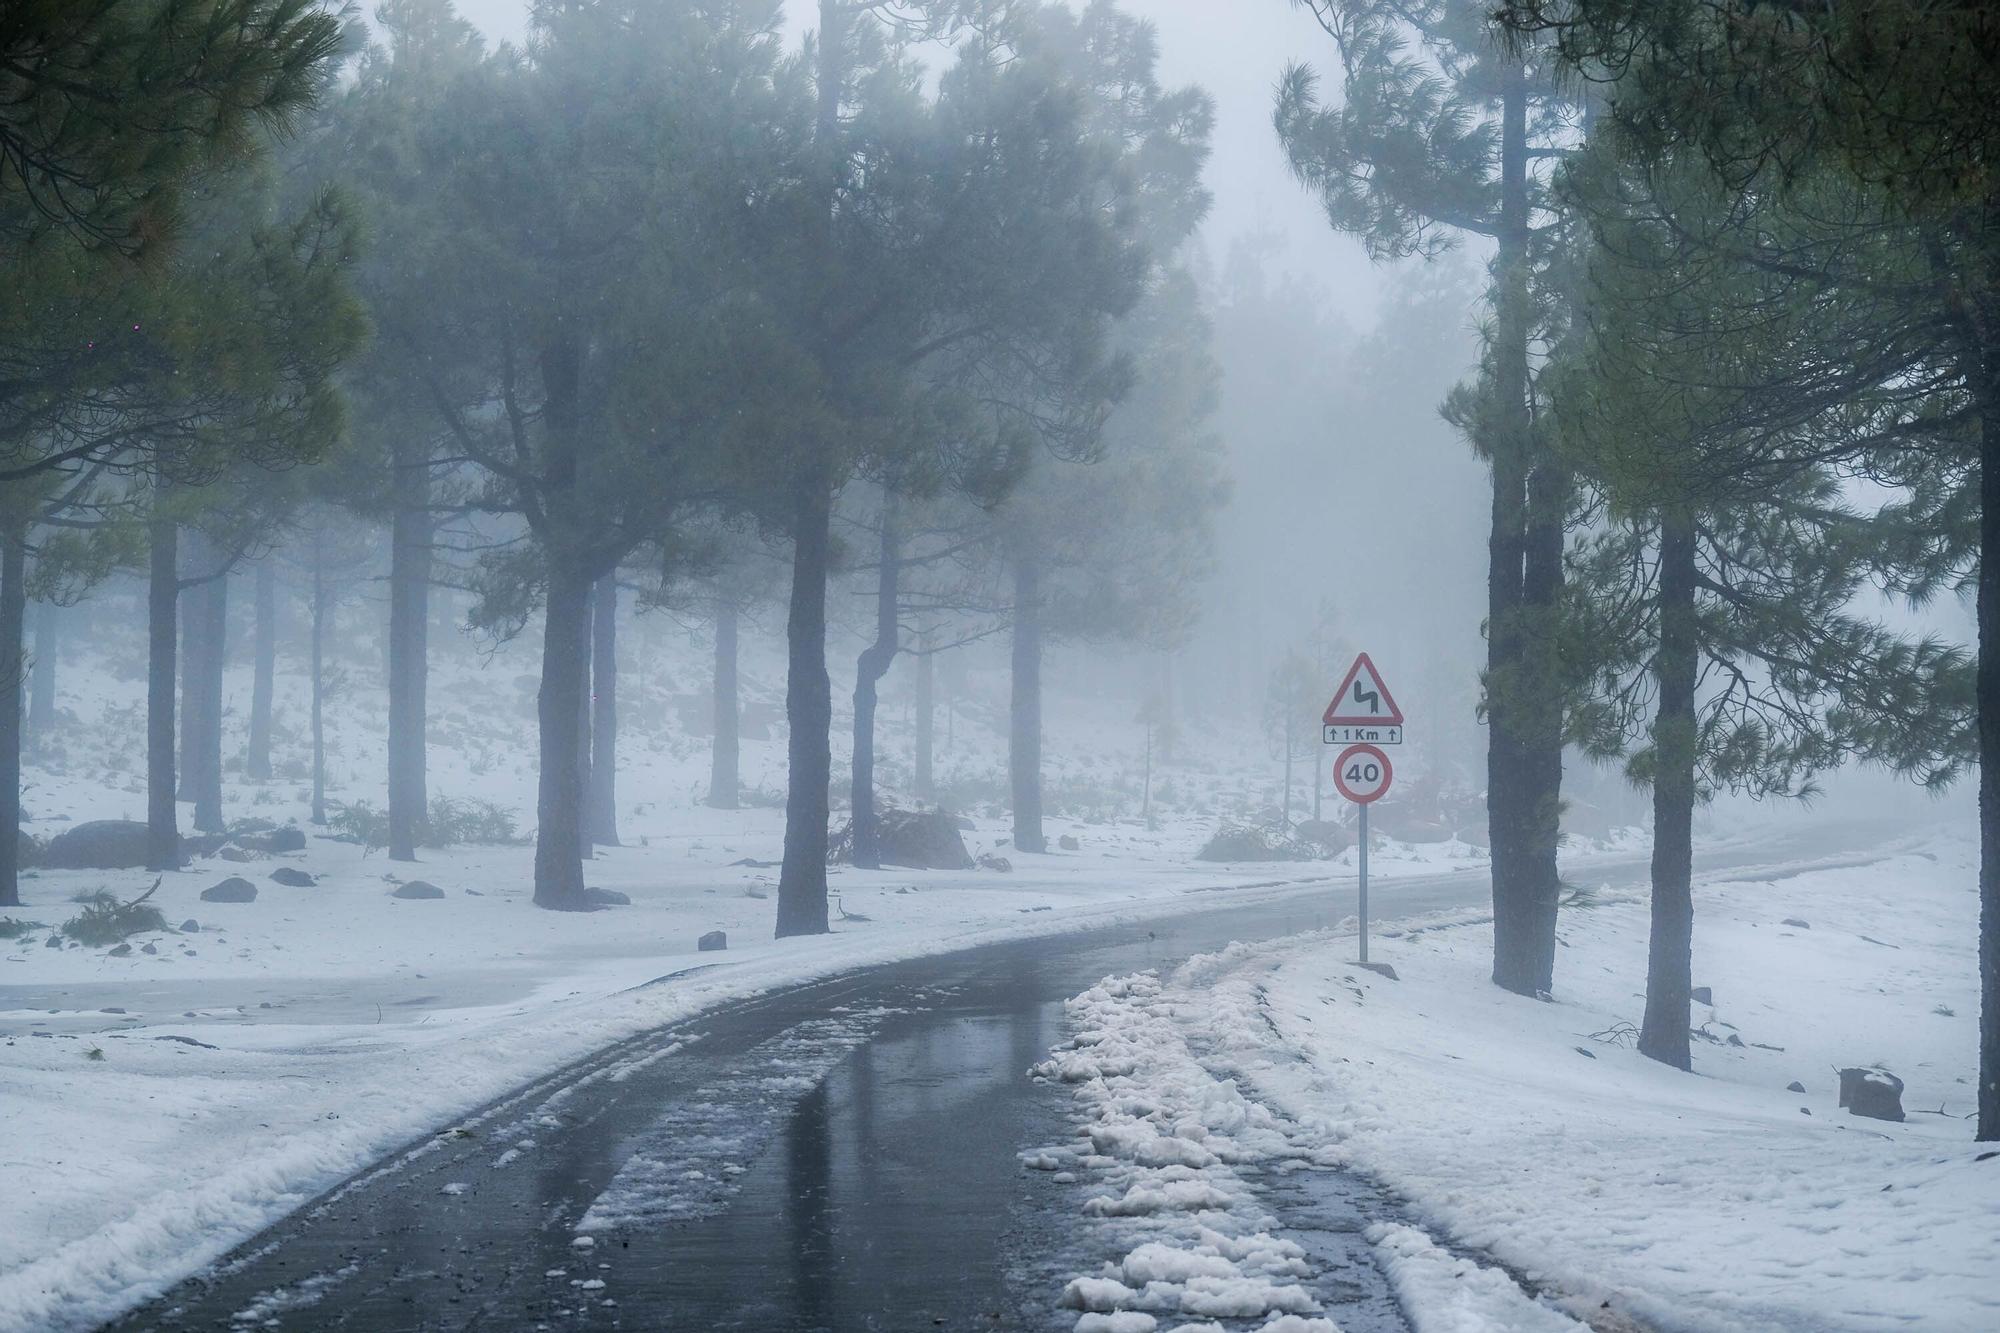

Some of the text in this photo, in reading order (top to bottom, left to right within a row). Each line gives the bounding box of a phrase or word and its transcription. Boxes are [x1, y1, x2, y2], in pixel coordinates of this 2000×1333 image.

[1343, 729, 1379, 740] 1 Km
[1345, 764, 1379, 783] 40
